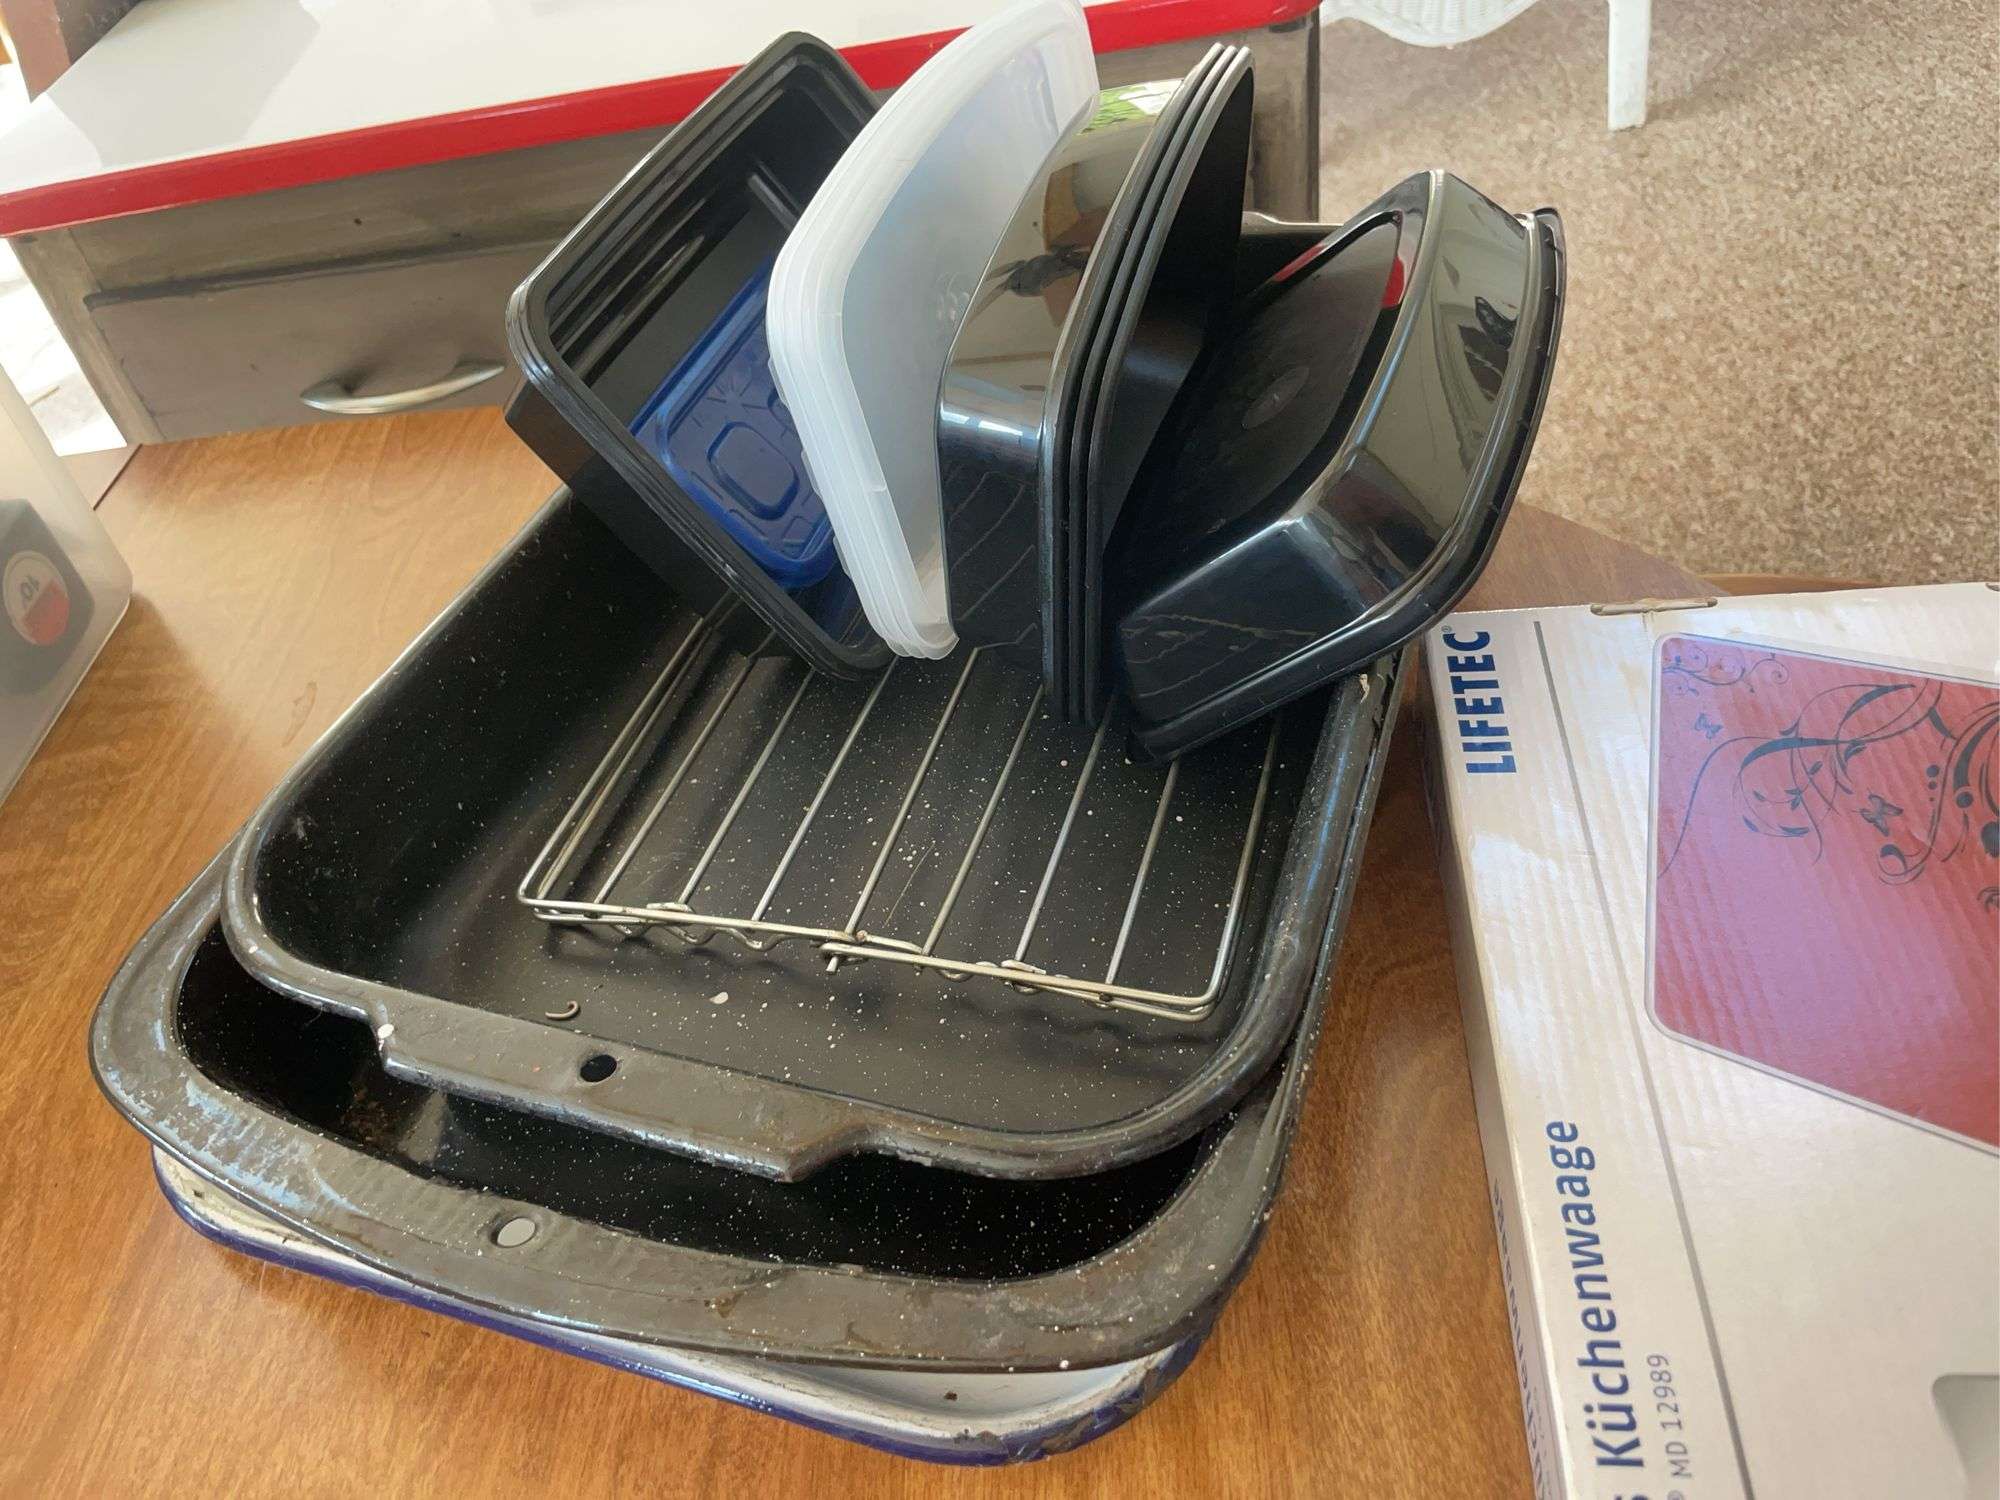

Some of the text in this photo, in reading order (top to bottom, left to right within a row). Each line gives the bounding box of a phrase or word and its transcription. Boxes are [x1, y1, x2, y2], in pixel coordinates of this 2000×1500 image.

[1545, 1120, 1645, 1467] Küchenwaage
[1646, 1354, 1683, 1430] 12989
[1665, 1441, 1693, 1479] MD
